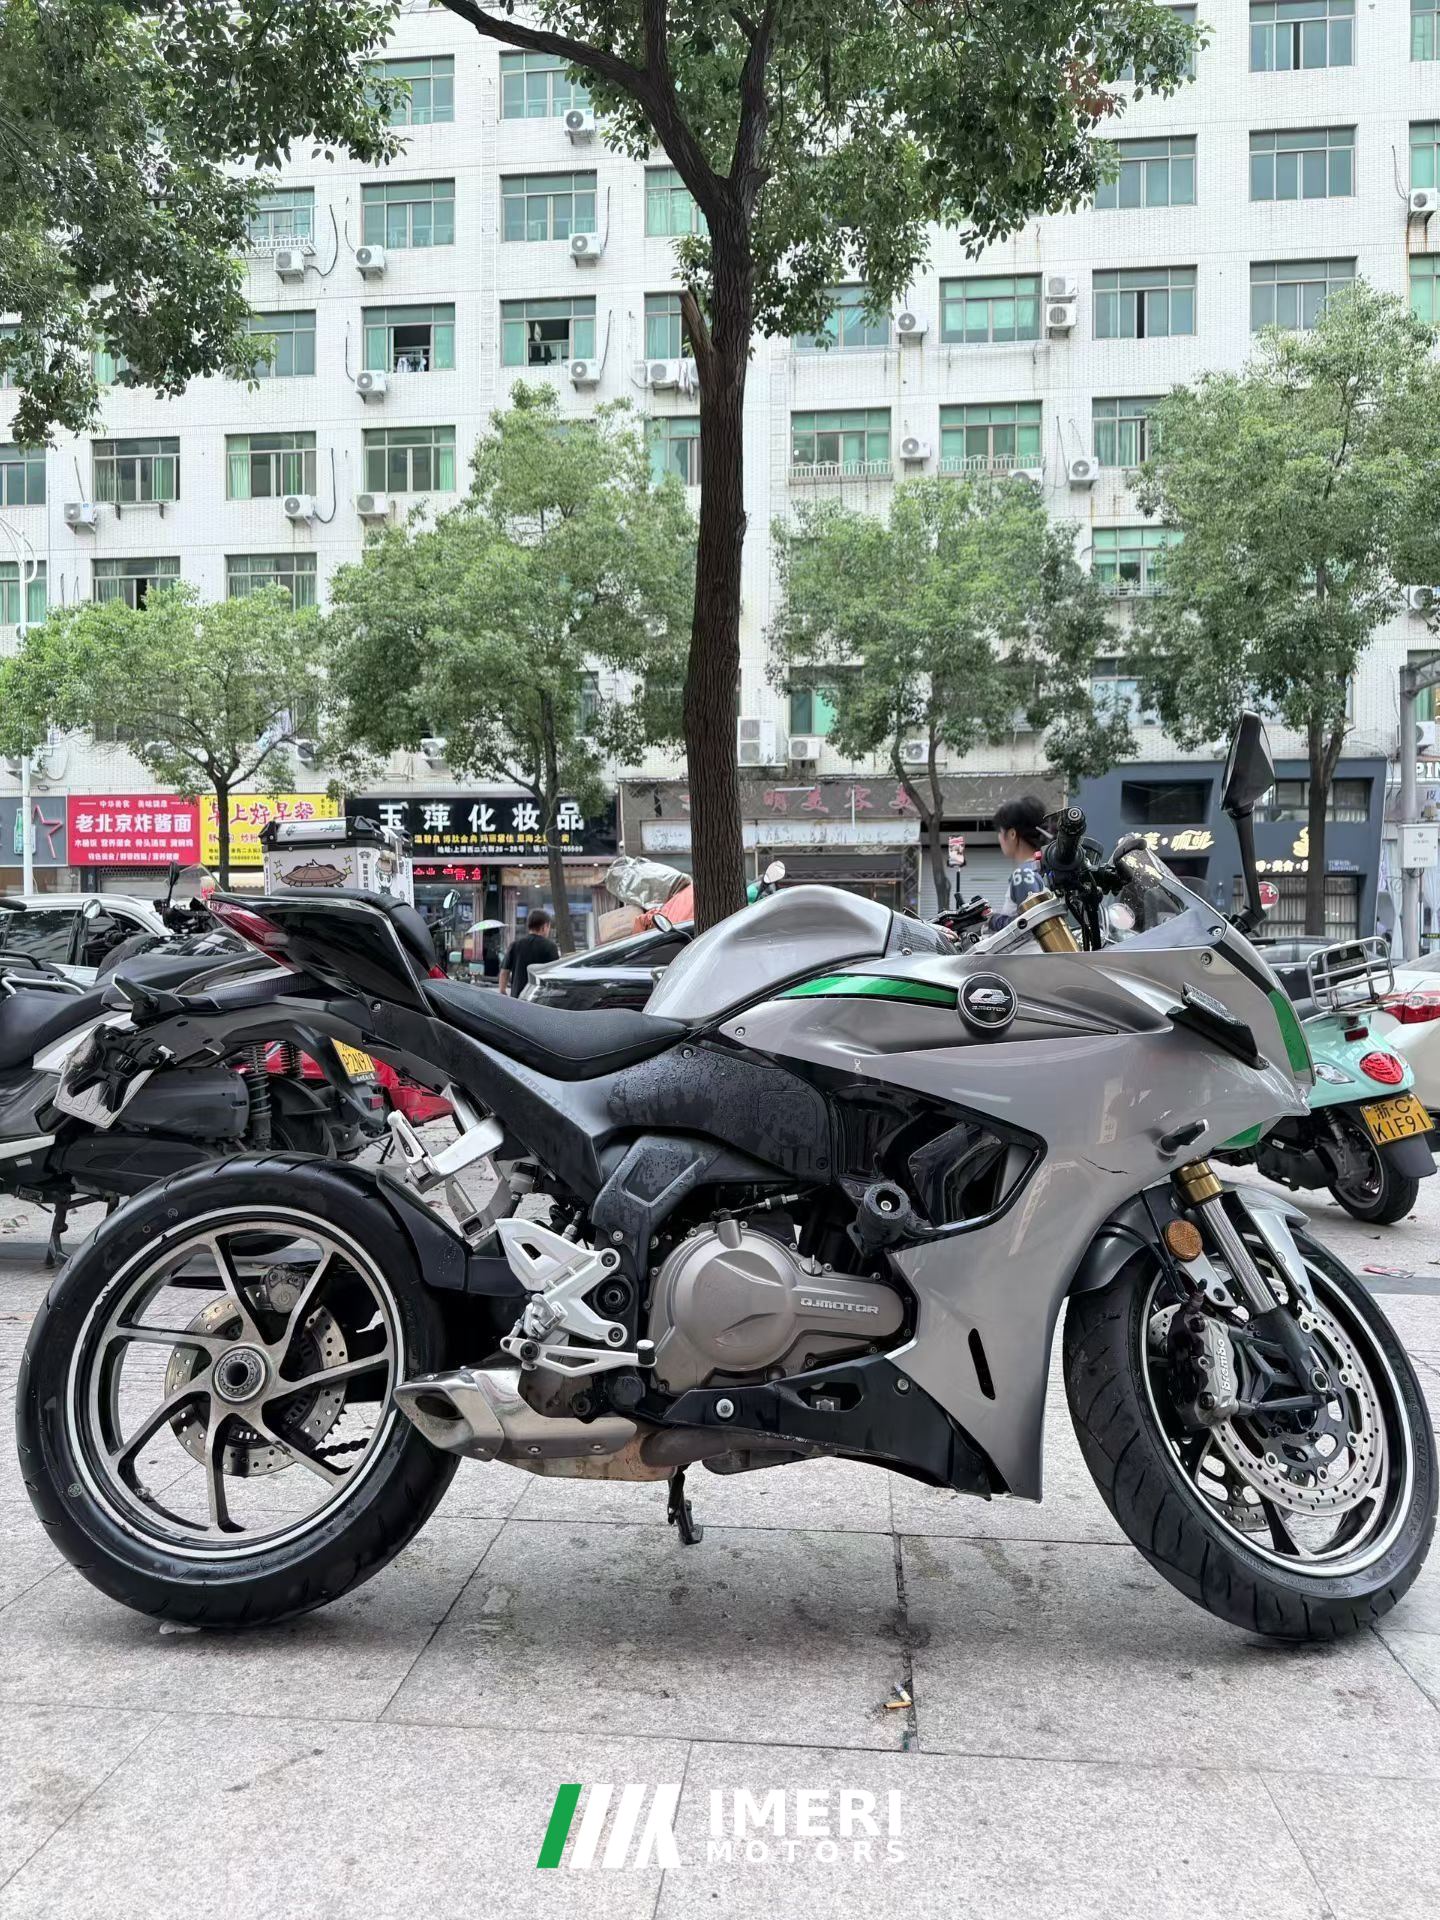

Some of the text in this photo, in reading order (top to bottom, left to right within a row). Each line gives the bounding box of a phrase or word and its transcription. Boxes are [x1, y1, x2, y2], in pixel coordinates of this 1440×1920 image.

[76, 814, 192, 833] 老北京炸酱面
[378, 802, 584, 831] 玉萍化妆品
[1013, 868, 1035, 886] 63
[1372, 1099, 1410, 1120] 浙·C
[800, 1297, 880, 1314] QJMOTOR
[1216, 1339, 1231, 1391] brembo
